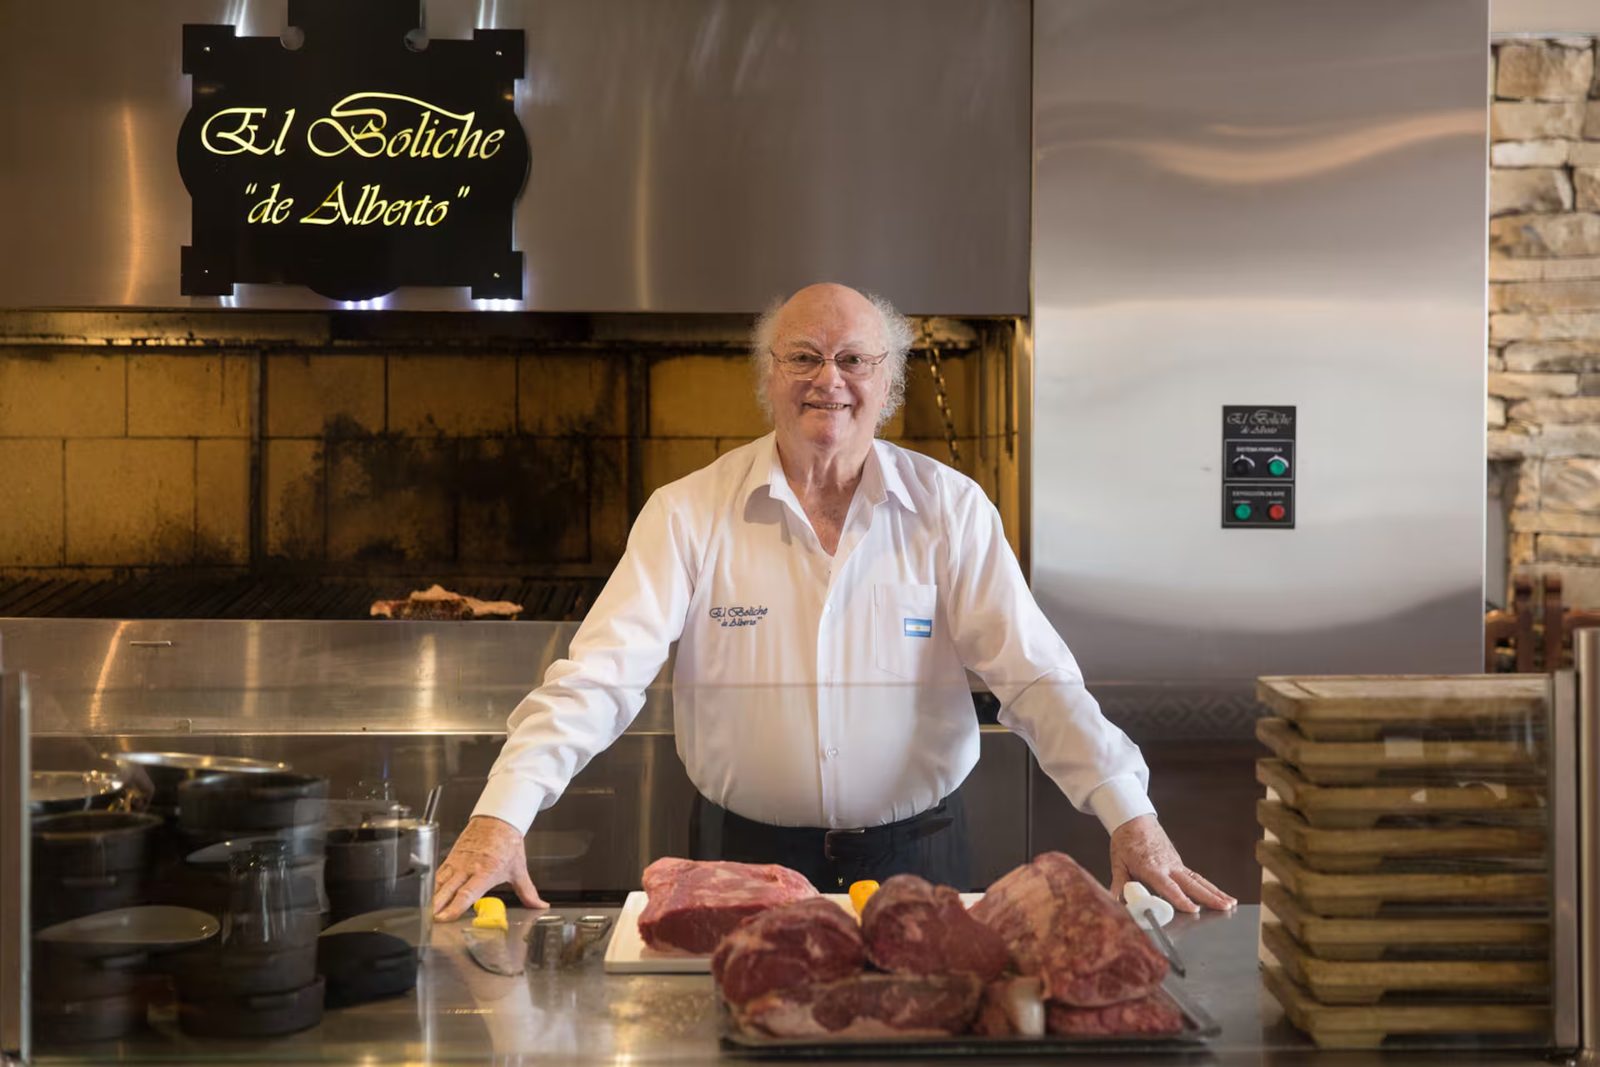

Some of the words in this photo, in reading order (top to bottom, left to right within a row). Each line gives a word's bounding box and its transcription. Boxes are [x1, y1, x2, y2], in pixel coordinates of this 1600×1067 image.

[201, 107, 296, 156] El
[307, 91, 506, 160] Boliche
[1226, 412, 1248, 425] El
[709, 606, 727, 619] El
[727, 605, 768, 618] Boliche
